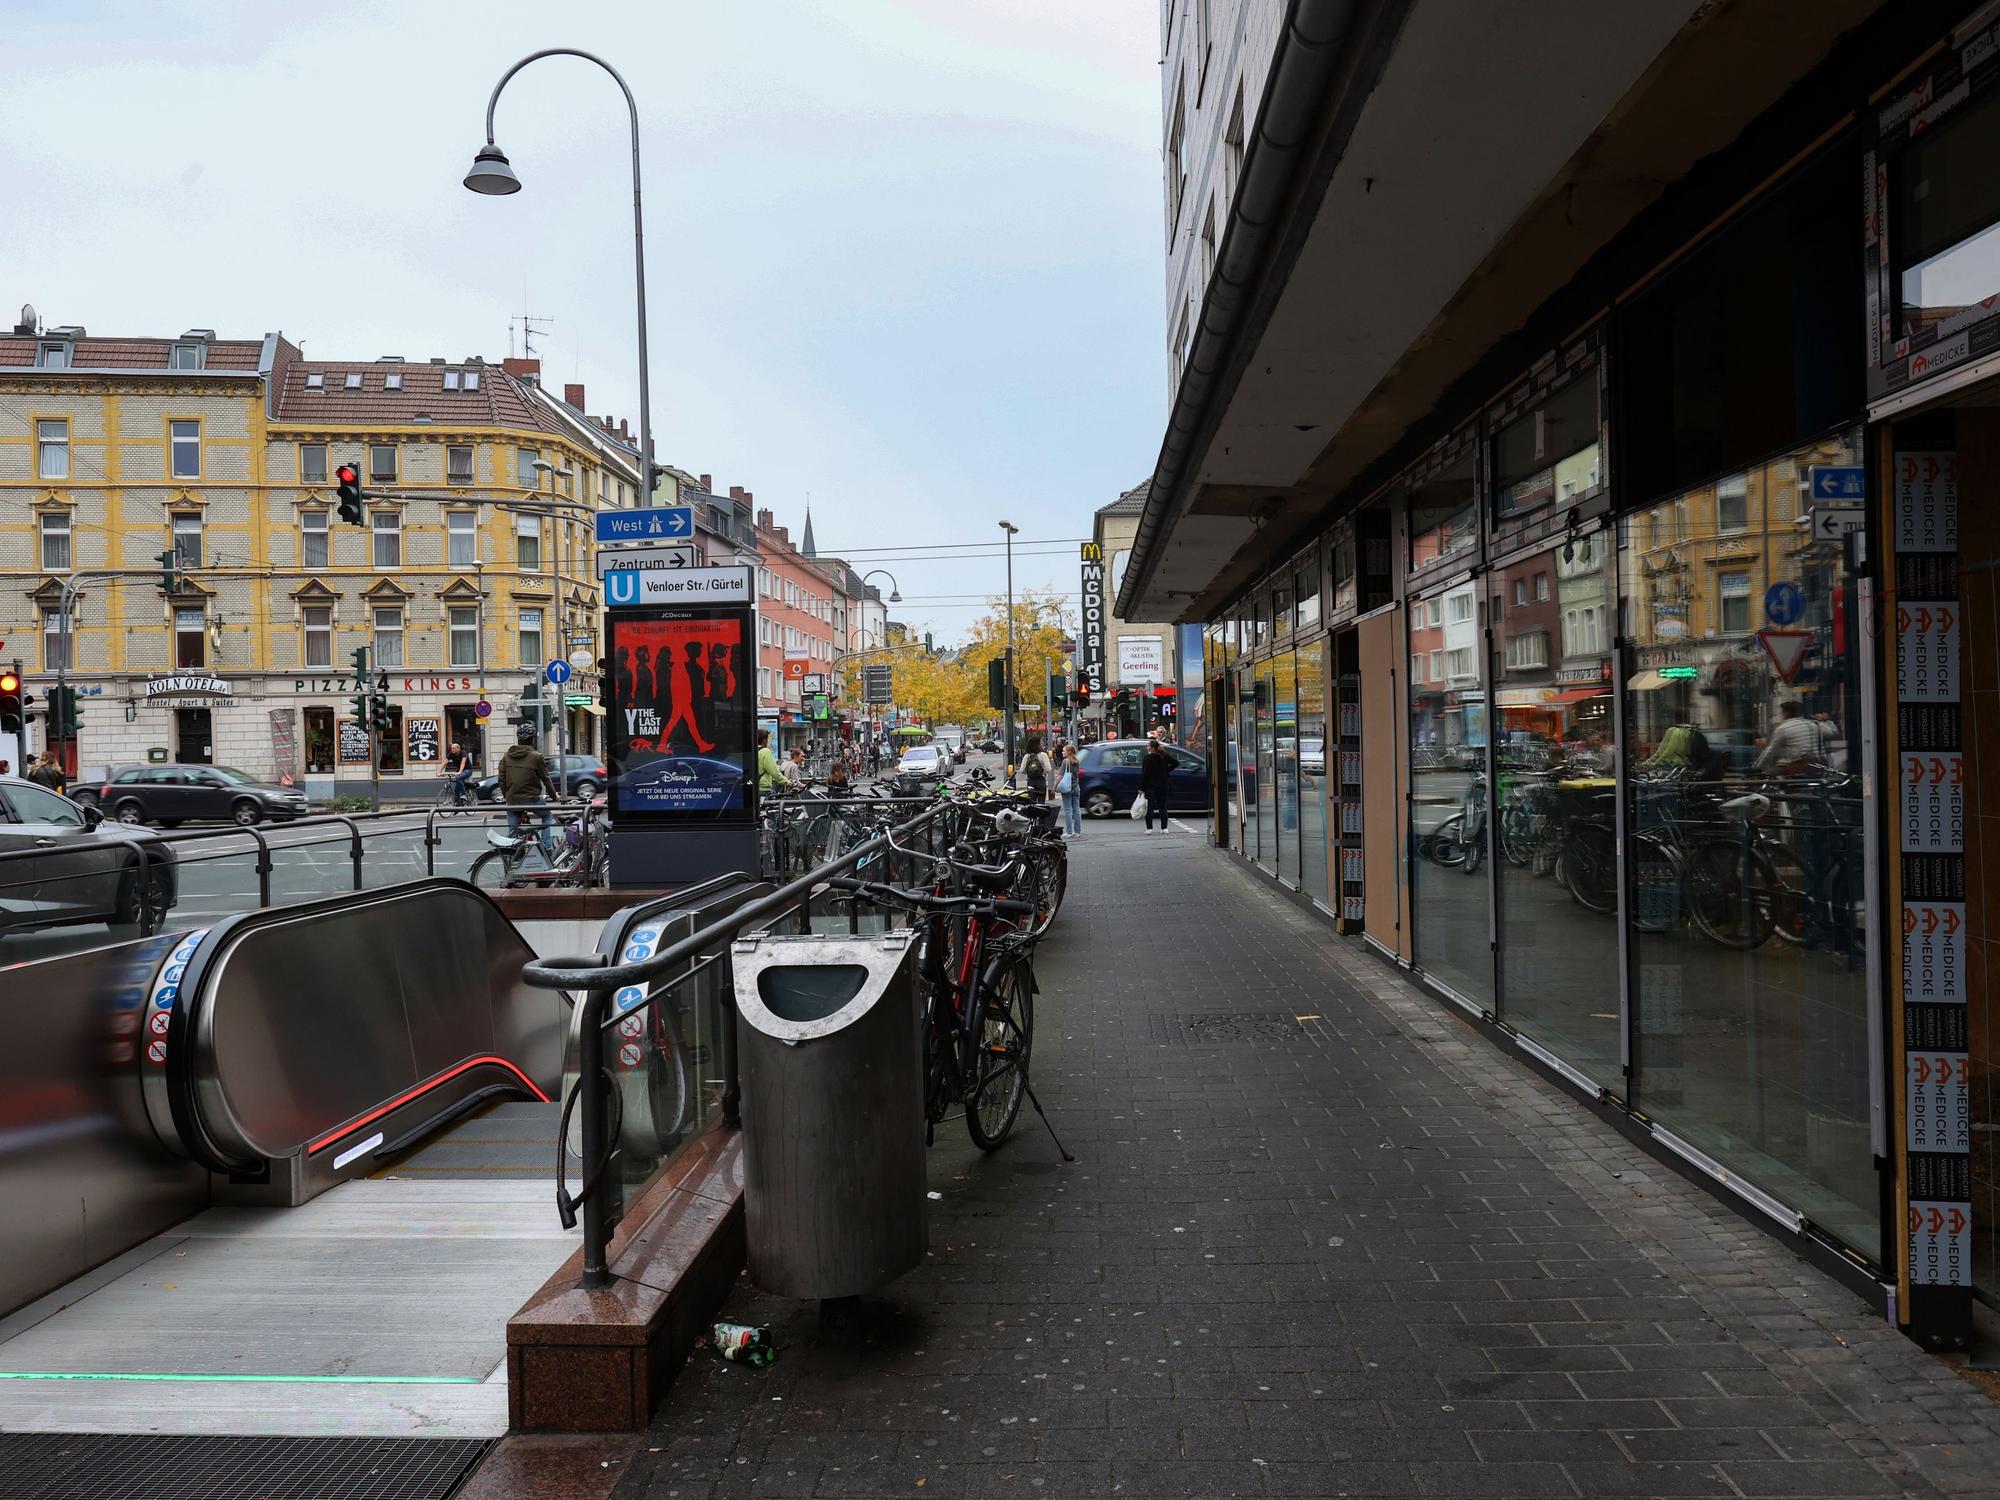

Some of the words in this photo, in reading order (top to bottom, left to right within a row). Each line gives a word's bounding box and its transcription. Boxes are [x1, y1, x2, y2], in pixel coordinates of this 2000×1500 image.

[1928, 344, 1966, 369] MEDICKE
[612, 520, 642, 532] West
[1903, 485, 1913, 545] MEDICKE
[1924, 485, 1934, 545] MEDICKE
[1945, 485, 1956, 545] MEDICKE
[611, 558, 664, 570] Zentrum
[612, 575, 633, 602] U
[647, 581, 684, 592] Venloer
[1084, 566, 1102, 691] McDonald's
[185, 678, 226, 693] OTEL.de
[296, 679, 363, 692] PIZZA
[377, 674, 390, 692] 4
[405, 678, 471, 690] KINGS
[1123, 662, 1159, 671] Geerling
[1916, 635, 1927, 696] MEDICKE
[1937, 635, 1948, 696] MEDICKE
[178, 698, 198, 706] Apart
[212, 698, 234, 706] Suites
[625, 709, 637, 735] Y
[638, 709, 654, 718] THE
[639, 717, 661, 726] LAST
[413, 720, 438, 731] PIZZA
[639, 727, 660, 735] MAN
[419, 744, 430, 760] 5
[1909, 785, 1919, 846] MEDICKE
[1930, 785, 1940, 846] MEDICKE
[1951, 785, 1962, 846] MEDICKE
[1922, 935, 1933, 995] MEDICKE
[1943, 936, 1954, 996] MEDICKE
[1915, 1086, 1925, 1145] MEDICKE
[1936, 1086, 1947, 1145] MEDICKE
[1957, 1086, 1968, 1146] MEDICKE
